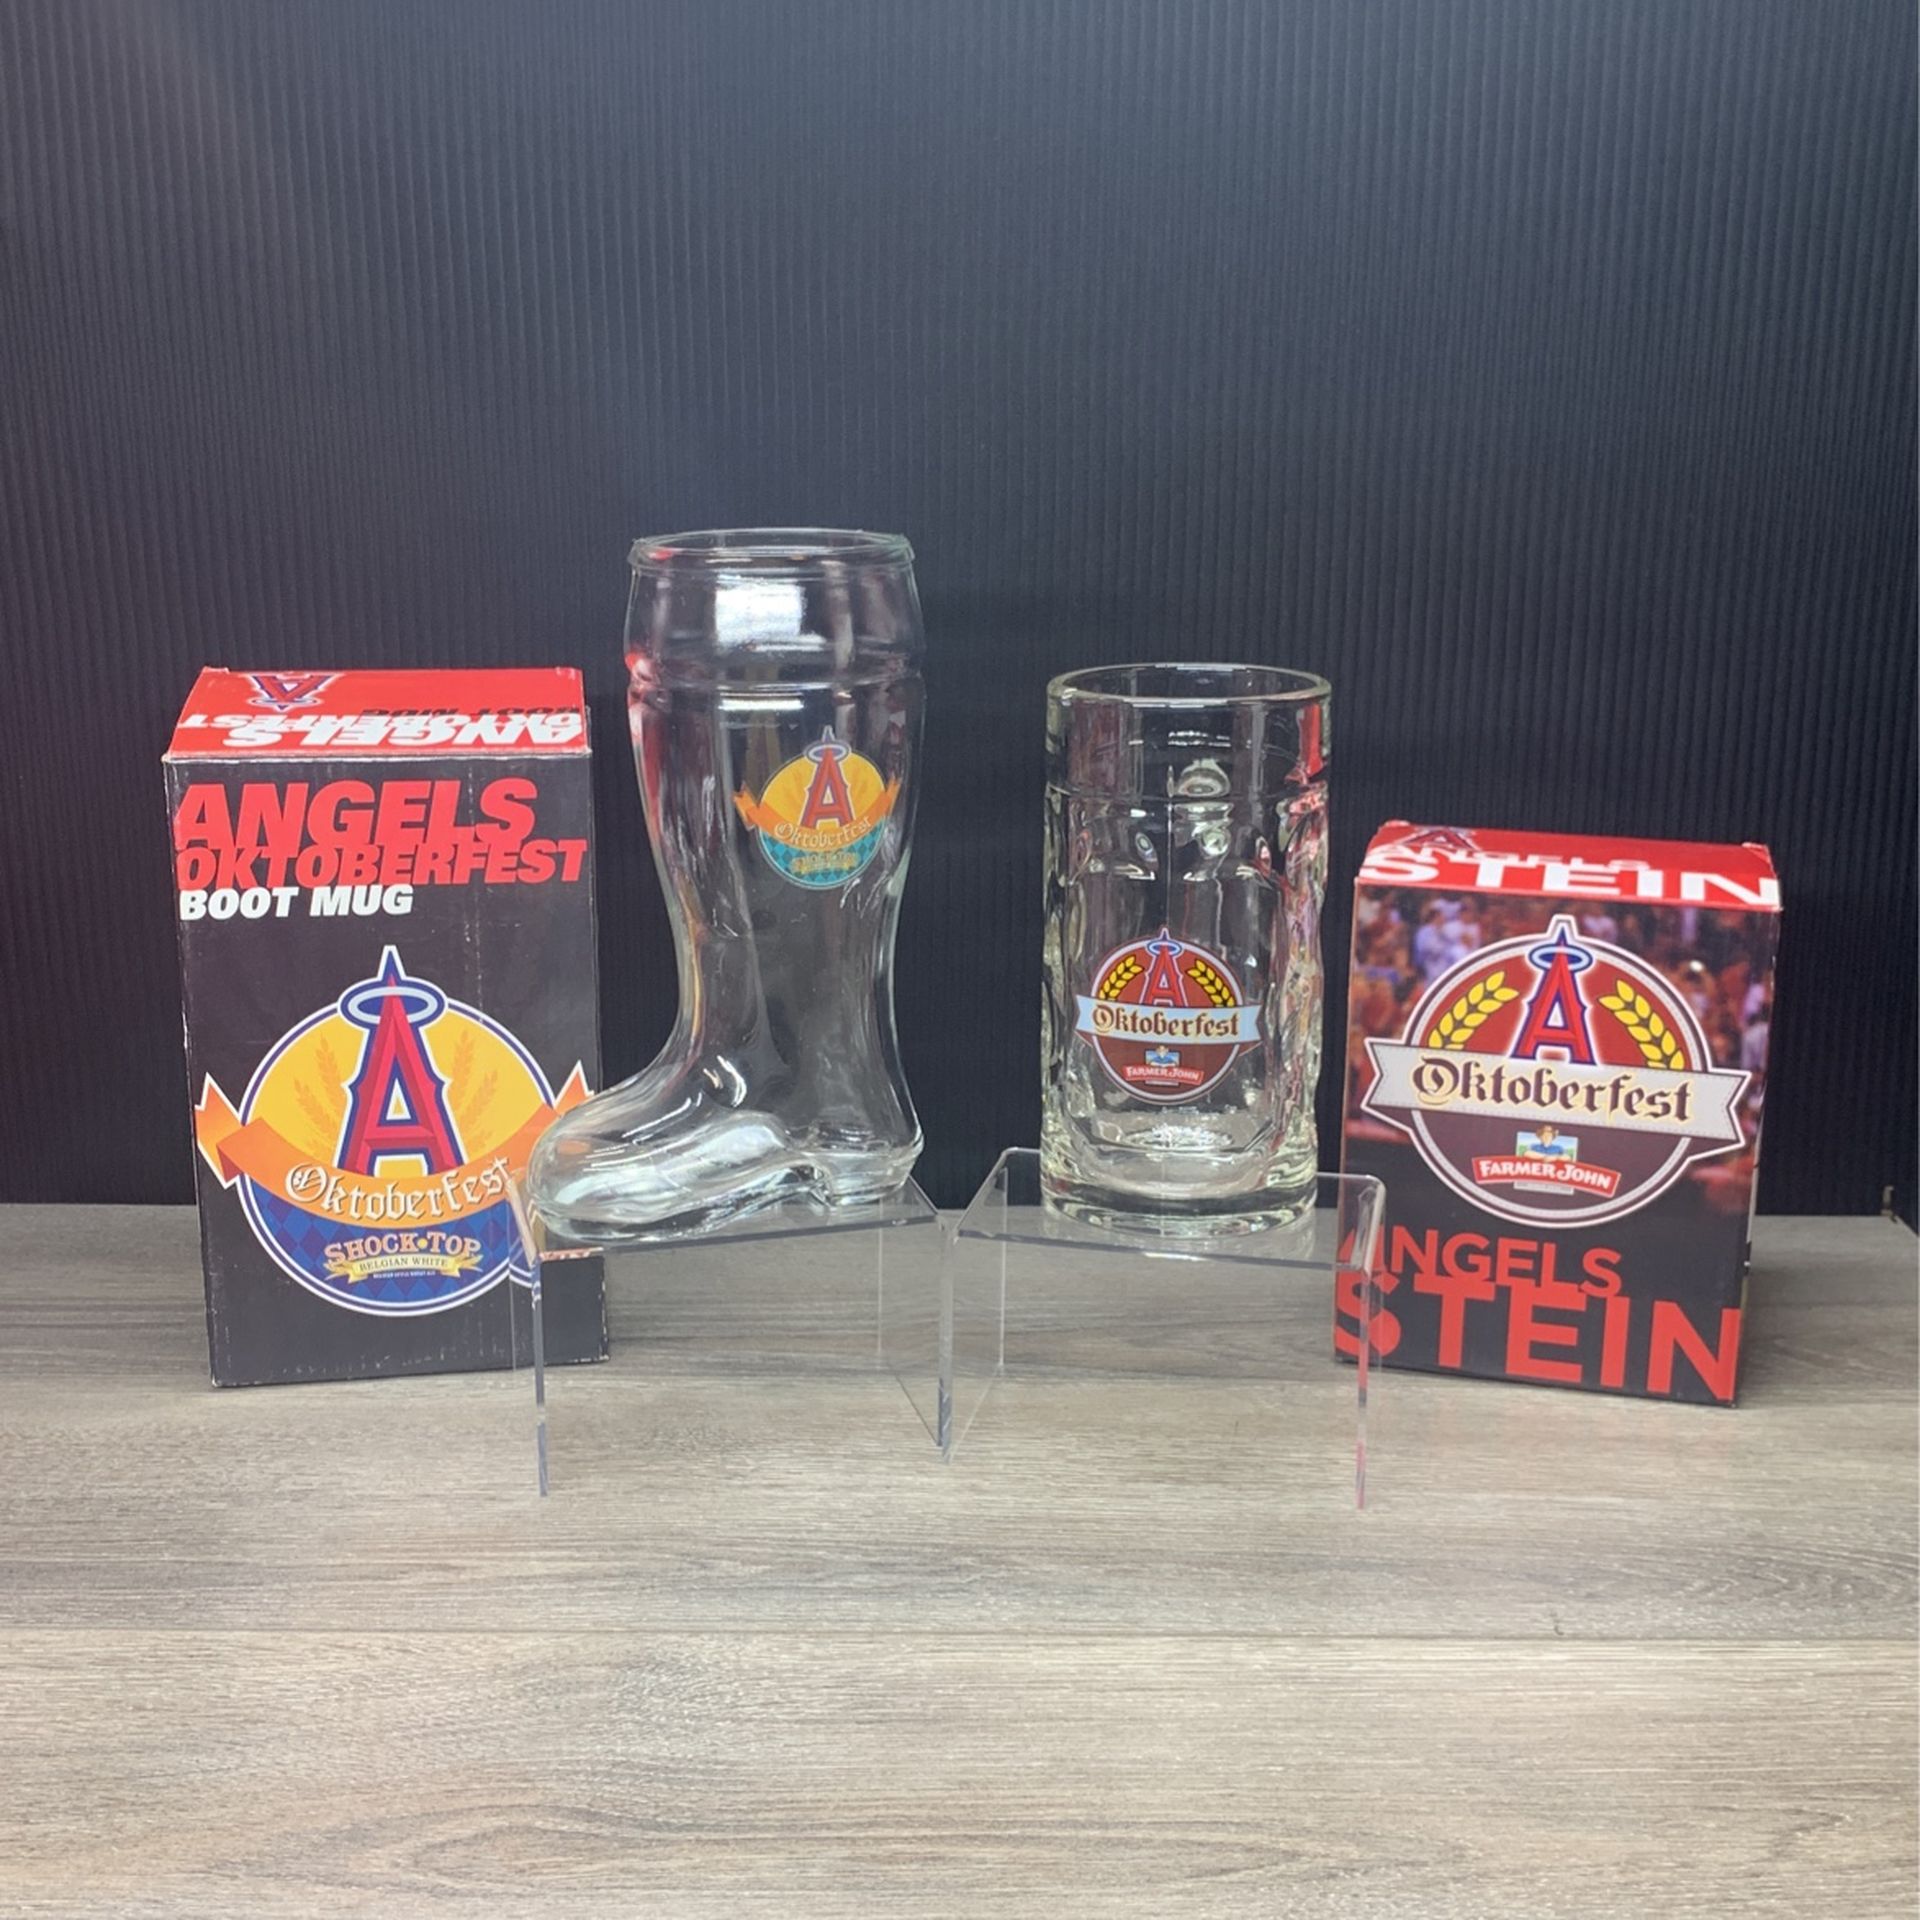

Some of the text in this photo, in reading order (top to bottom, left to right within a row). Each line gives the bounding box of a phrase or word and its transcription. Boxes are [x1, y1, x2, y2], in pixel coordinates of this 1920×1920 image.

[222, 725, 583, 747] ANGELS
[800, 725, 856, 830] A
[175, 777, 538, 852] ANGELS
[774, 816, 871, 848] Oktoberfest
[176, 840, 587, 890] OKTOBERFEST
[1358, 852, 1780, 905] STEIN
[180, 884, 413, 920] BOOT MUG
[1139, 928, 1188, 1006] A
[1510, 914, 1599, 1066] A
[1092, 1004, 1239, 1037] Oktoberfest
[332, 945, 467, 1177] A
[1126, 1066, 1200, 1081] FARMER JOHN
[1411, 1054, 1692, 1121] Oktoberfest
[284, 1155, 511, 1222] Oktoberfest
[1479, 1160, 1556, 1179] FARMER
[1557, 1163, 1612, 1189] JOHN
[358, 1257, 449, 1273] BELGIAN WHITE
[1335, 1271, 1742, 1400] STEIN
